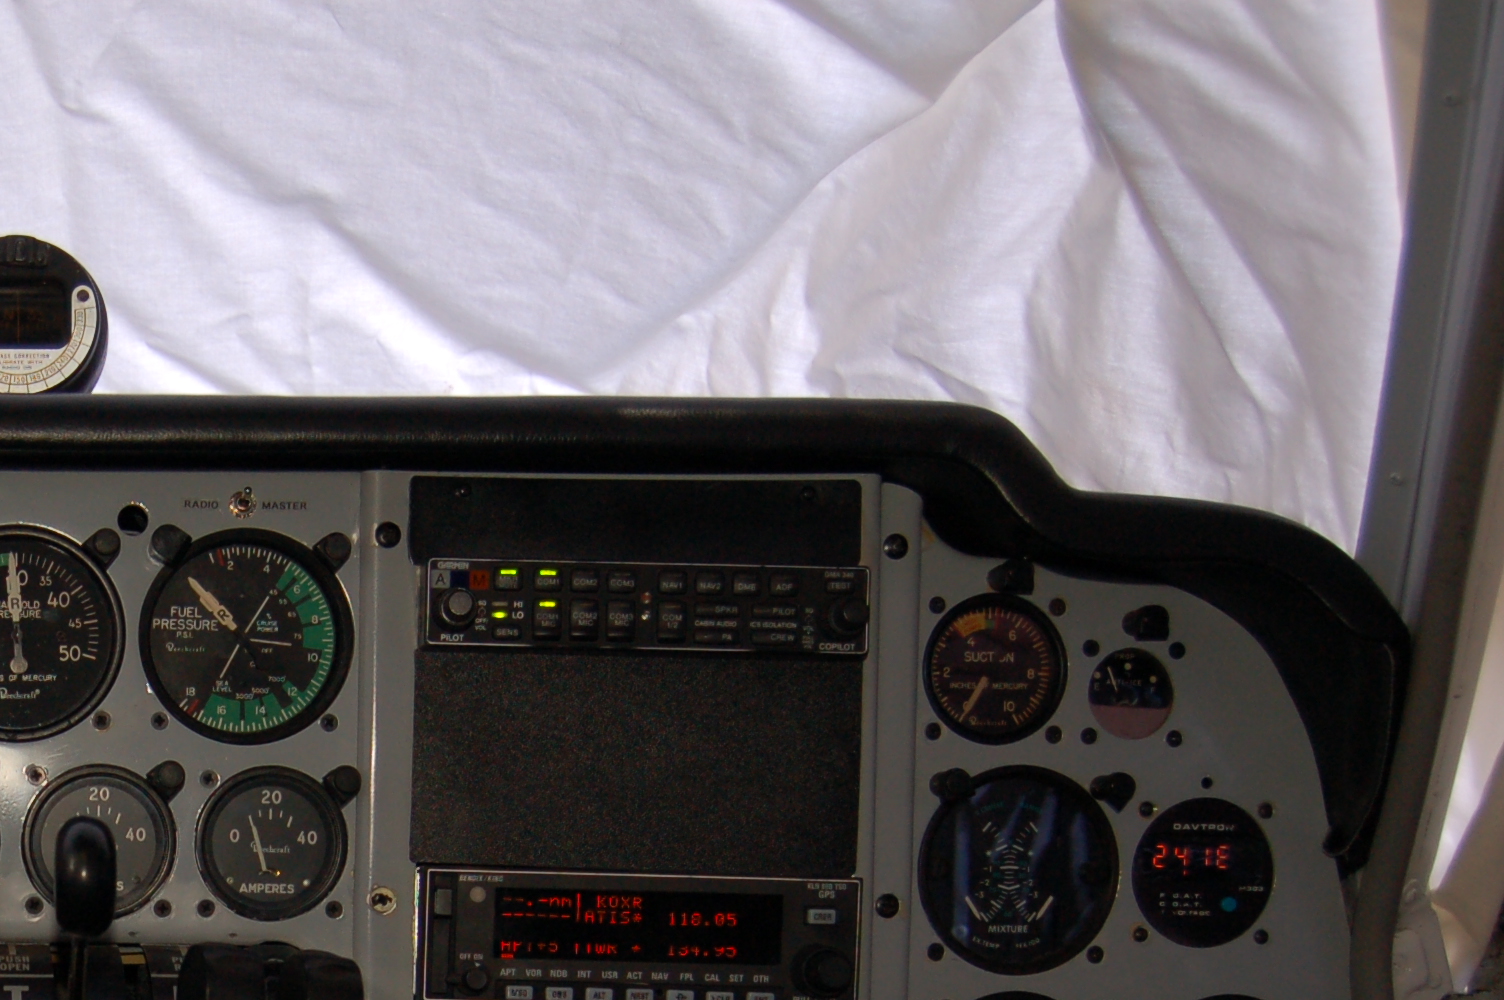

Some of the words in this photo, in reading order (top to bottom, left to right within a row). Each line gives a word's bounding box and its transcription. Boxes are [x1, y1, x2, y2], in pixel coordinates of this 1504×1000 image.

[184, 501, 219, 509] RADIO
[261, 502, 307, 511] MASTER
[39, 577, 52, 586] 35
[47, 592, 71, 608] 40
[170, 606, 202, 618] FUEL
[68, 618, 82, 628] 45
[153, 620, 219, 631] PRESSURE
[440, 634, 464, 642] PILOT
[59, 646, 81, 662] 50
[89, 787, 110, 801] 20
[261, 790, 282, 804] 20
[1173, 823, 1235, 831] DAVTRON
[125, 828, 146, 842] 40
[297, 831, 317, 845] 40
[239, 883, 295, 894] AMPERES
[818, 891, 835, 899] GPS
[987, 925, 1029, 933] MIXTURE
[0, 963, 30, 971] OPEN
[500, 968, 516, 976] APT
[526, 969, 542, 977] VOR
[550, 970, 568, 978] NDB
[577, 970, 591, 978] INT
[602, 971, 618, 979] USR
[651, 972, 669, 981] NAV
[680, 973, 694, 981] FPL
[704, 974, 720, 982] CAL
[729, 974, 744, 982] SET
[753, 975, 770, 983] OTH
